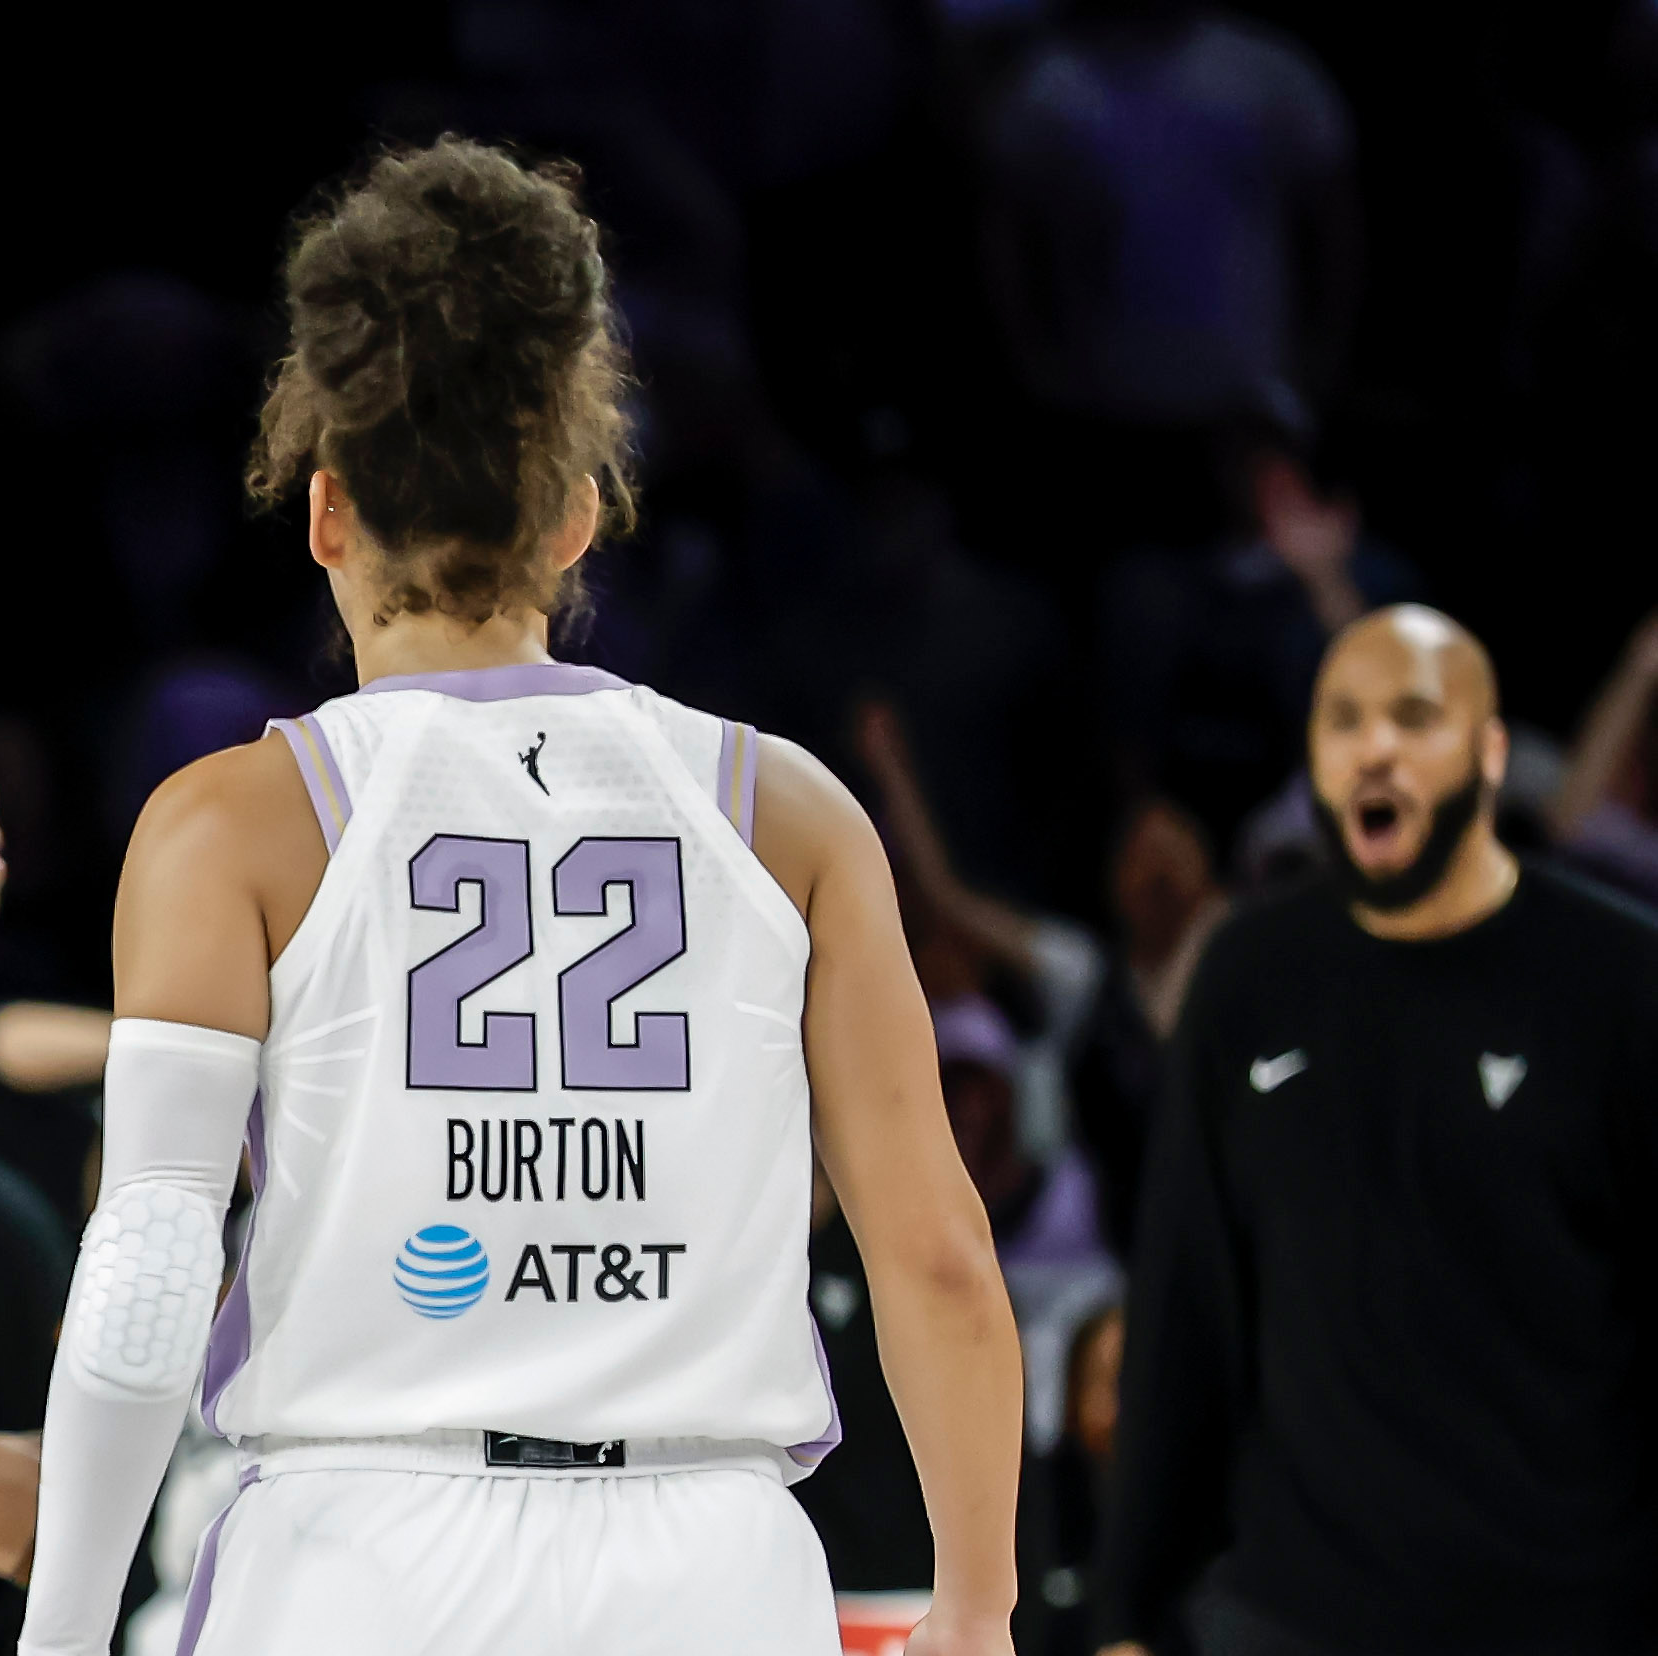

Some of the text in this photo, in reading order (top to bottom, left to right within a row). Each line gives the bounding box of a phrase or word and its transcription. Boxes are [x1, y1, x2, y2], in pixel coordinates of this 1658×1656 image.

[404, 832, 691, 1093] 22
[445, 1117, 648, 1203] BURTON
[504, 1242, 688, 1304] AT&T
